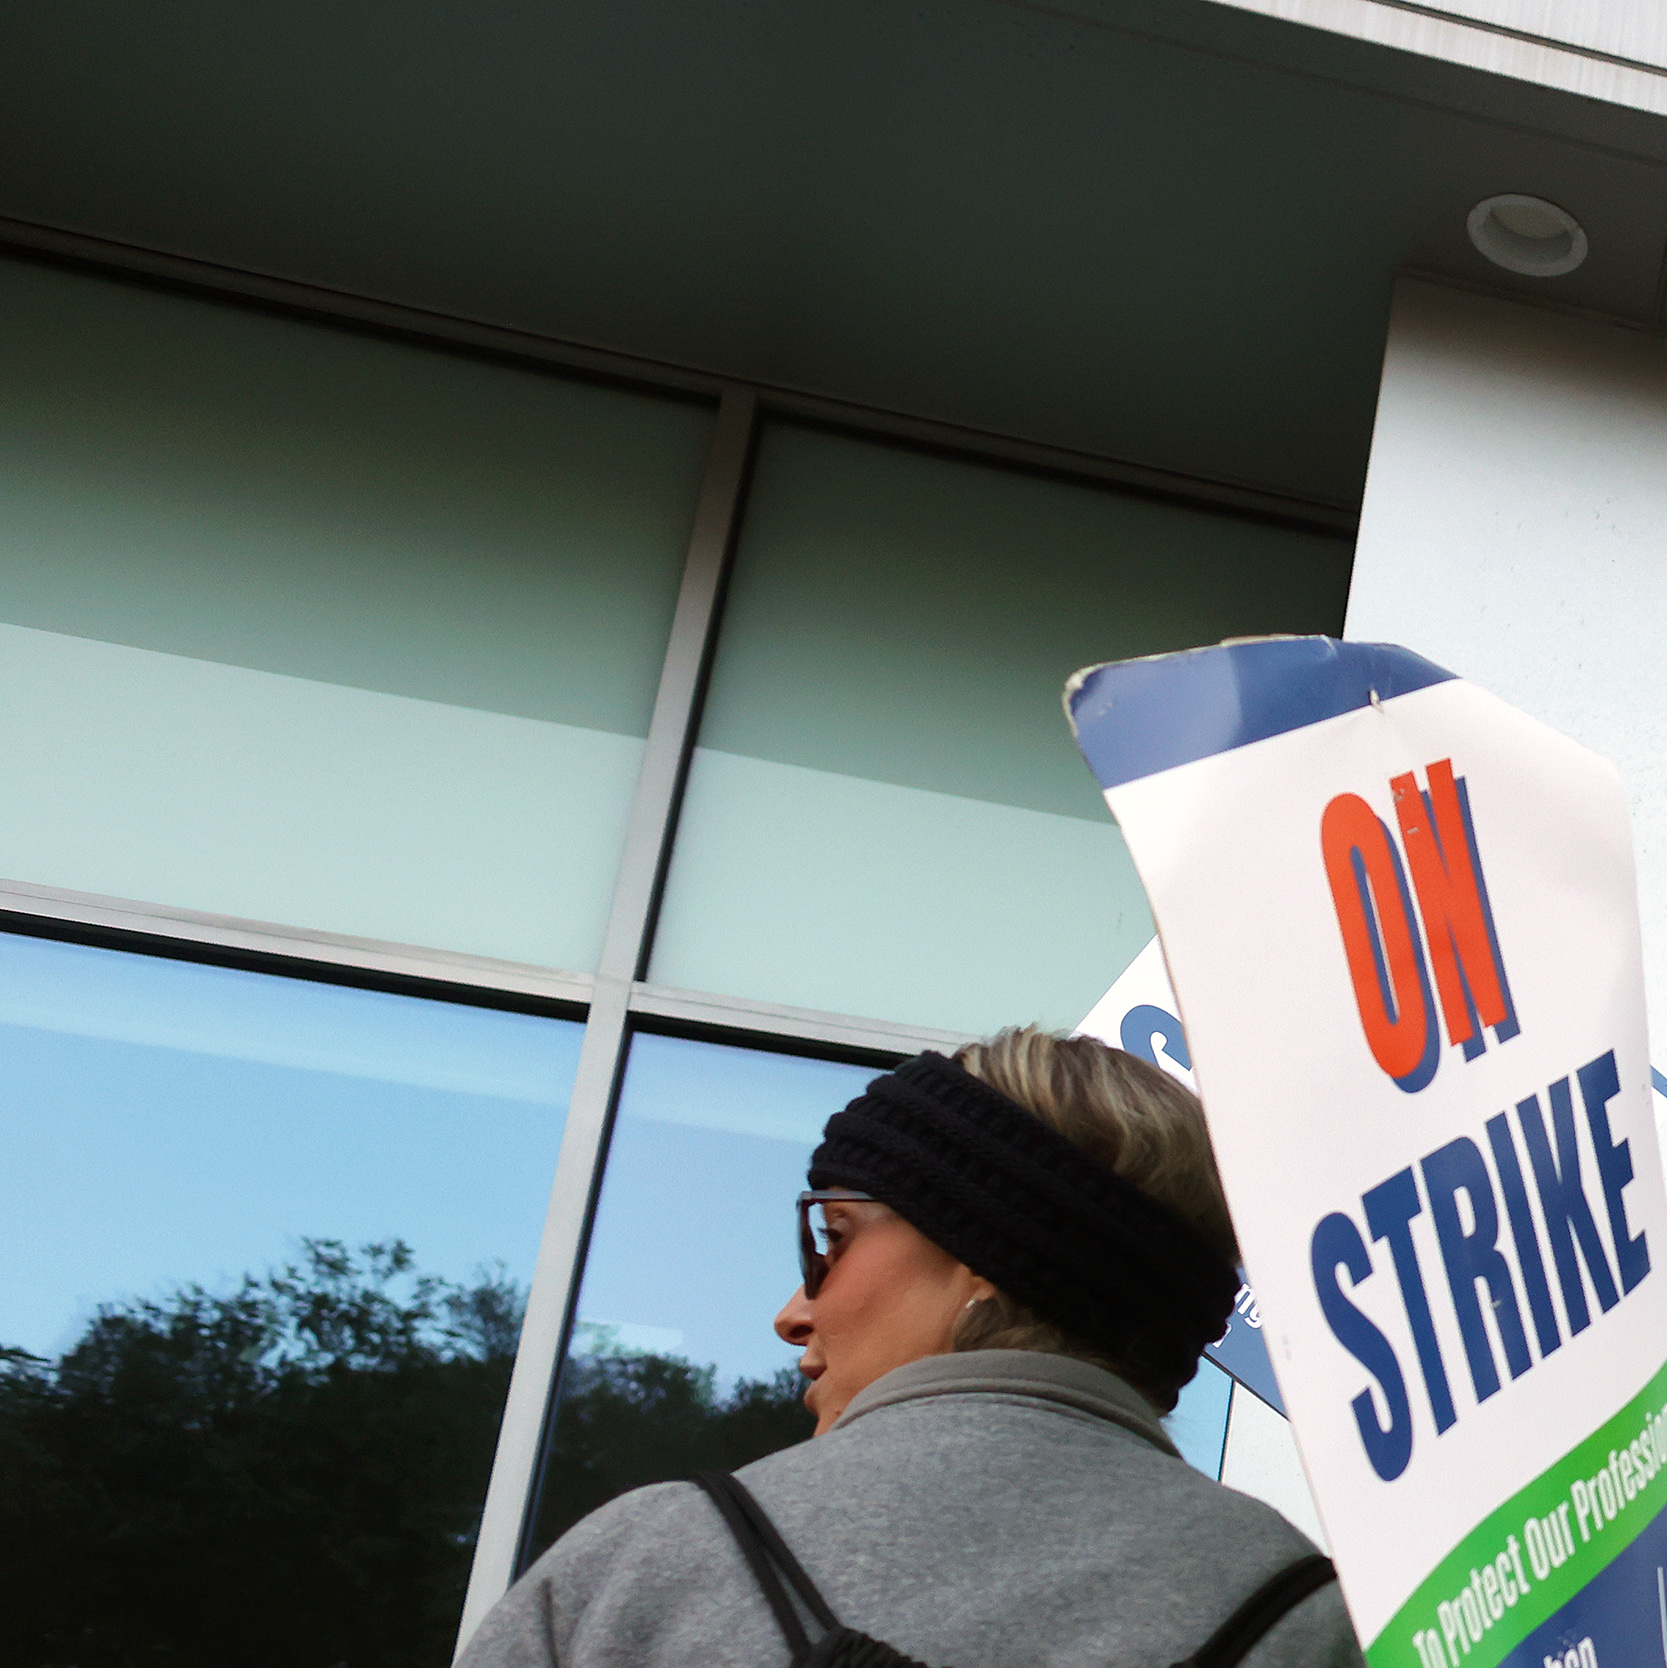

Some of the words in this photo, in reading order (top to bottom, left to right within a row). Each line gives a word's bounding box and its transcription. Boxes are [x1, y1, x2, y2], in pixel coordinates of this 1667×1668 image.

[1321, 757, 1520, 1093] ON
[1310, 1048, 1652, 1482] STRIKE
[1436, 1533, 1532, 1668] Protect
[1523, 1499, 1576, 1581] Our
